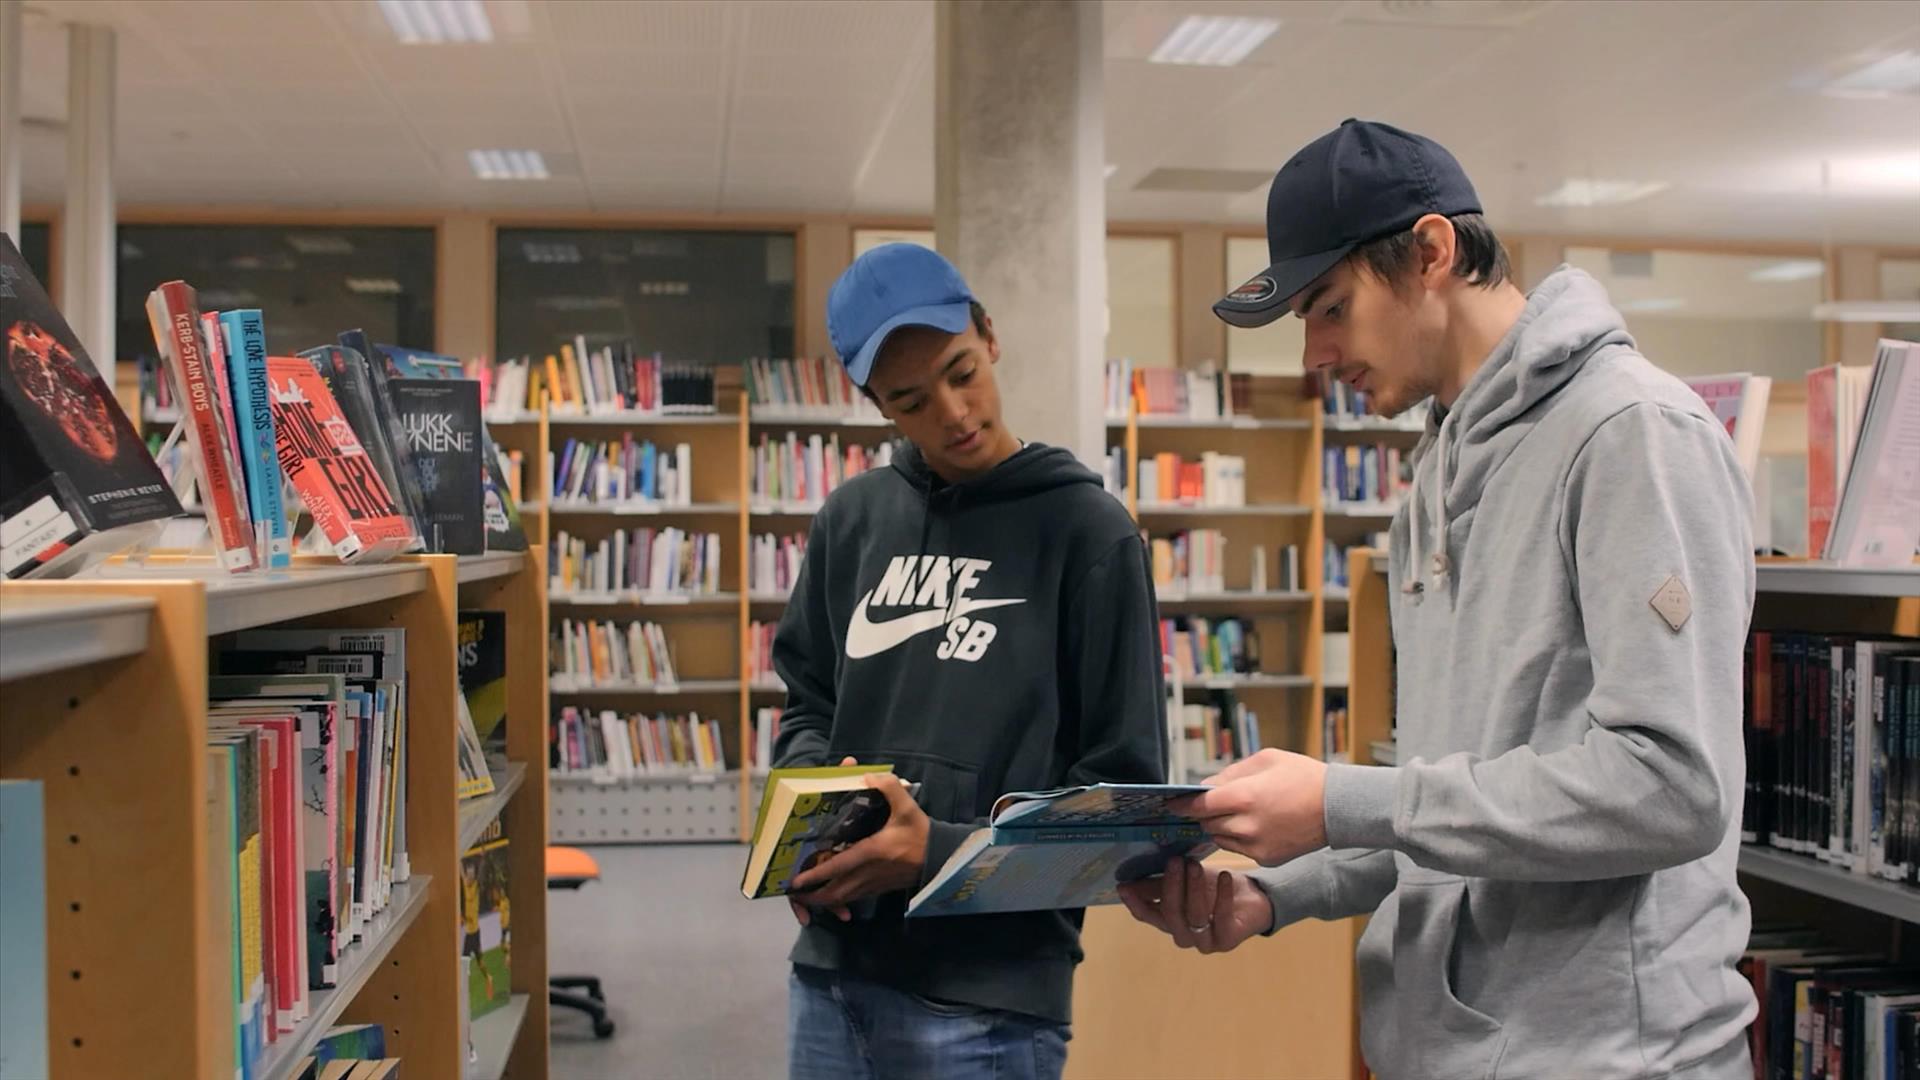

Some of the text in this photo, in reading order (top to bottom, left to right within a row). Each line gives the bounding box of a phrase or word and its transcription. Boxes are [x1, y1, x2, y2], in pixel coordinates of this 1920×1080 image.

[175, 313, 210, 412] KERB-STAIN BOYS
[243, 319, 272, 431] THE LOVE HYPOTHESIS
[277, 444, 305, 482] GIRL
[316, 456, 402, 520] GIRL
[265, 467, 279, 535] LAURA STEVEN
[869, 555, 993, 608] NIKE
[936, 616, 998, 663] SB
